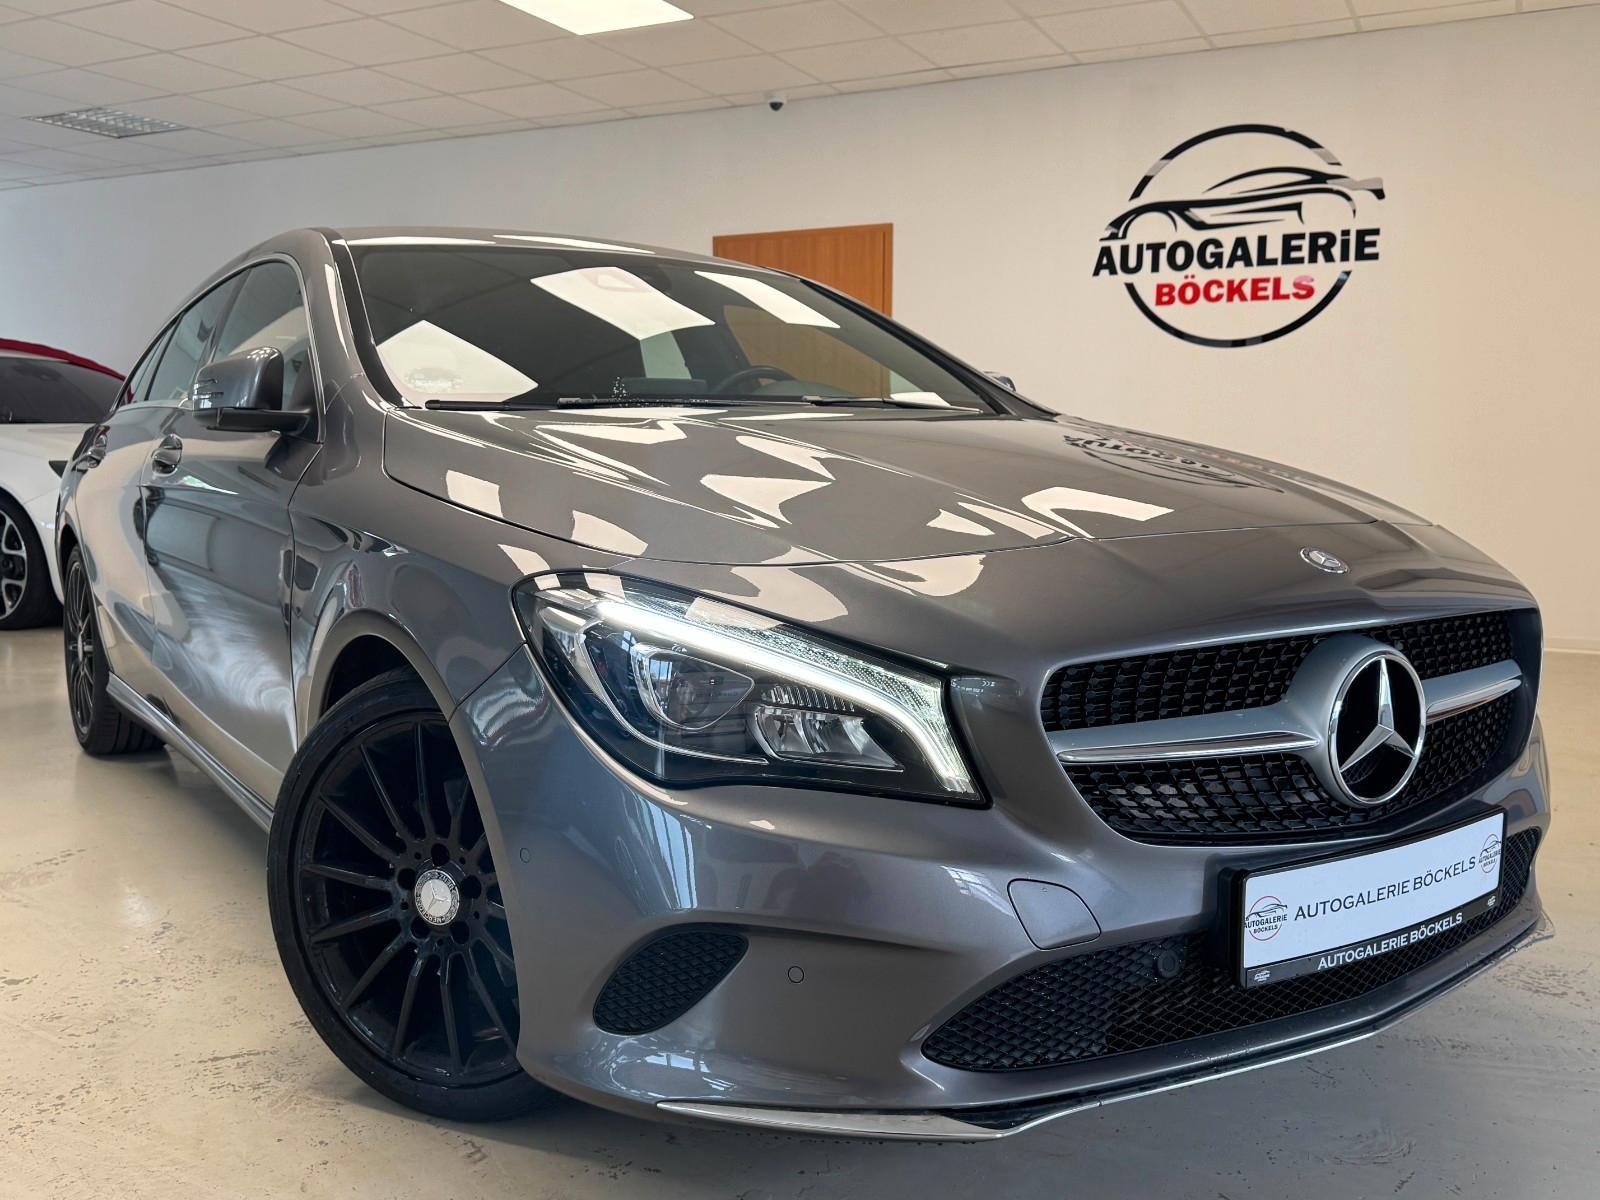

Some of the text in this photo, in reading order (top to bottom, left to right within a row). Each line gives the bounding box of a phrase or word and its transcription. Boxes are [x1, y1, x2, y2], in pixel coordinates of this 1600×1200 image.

[1155, 275, 1315, 306] BÖCKELS
[1294, 856, 1476, 921] AUTOGALERIE BÖCKELS
[1317, 912, 1463, 970] AUTOGALERIE BÖCKELS
